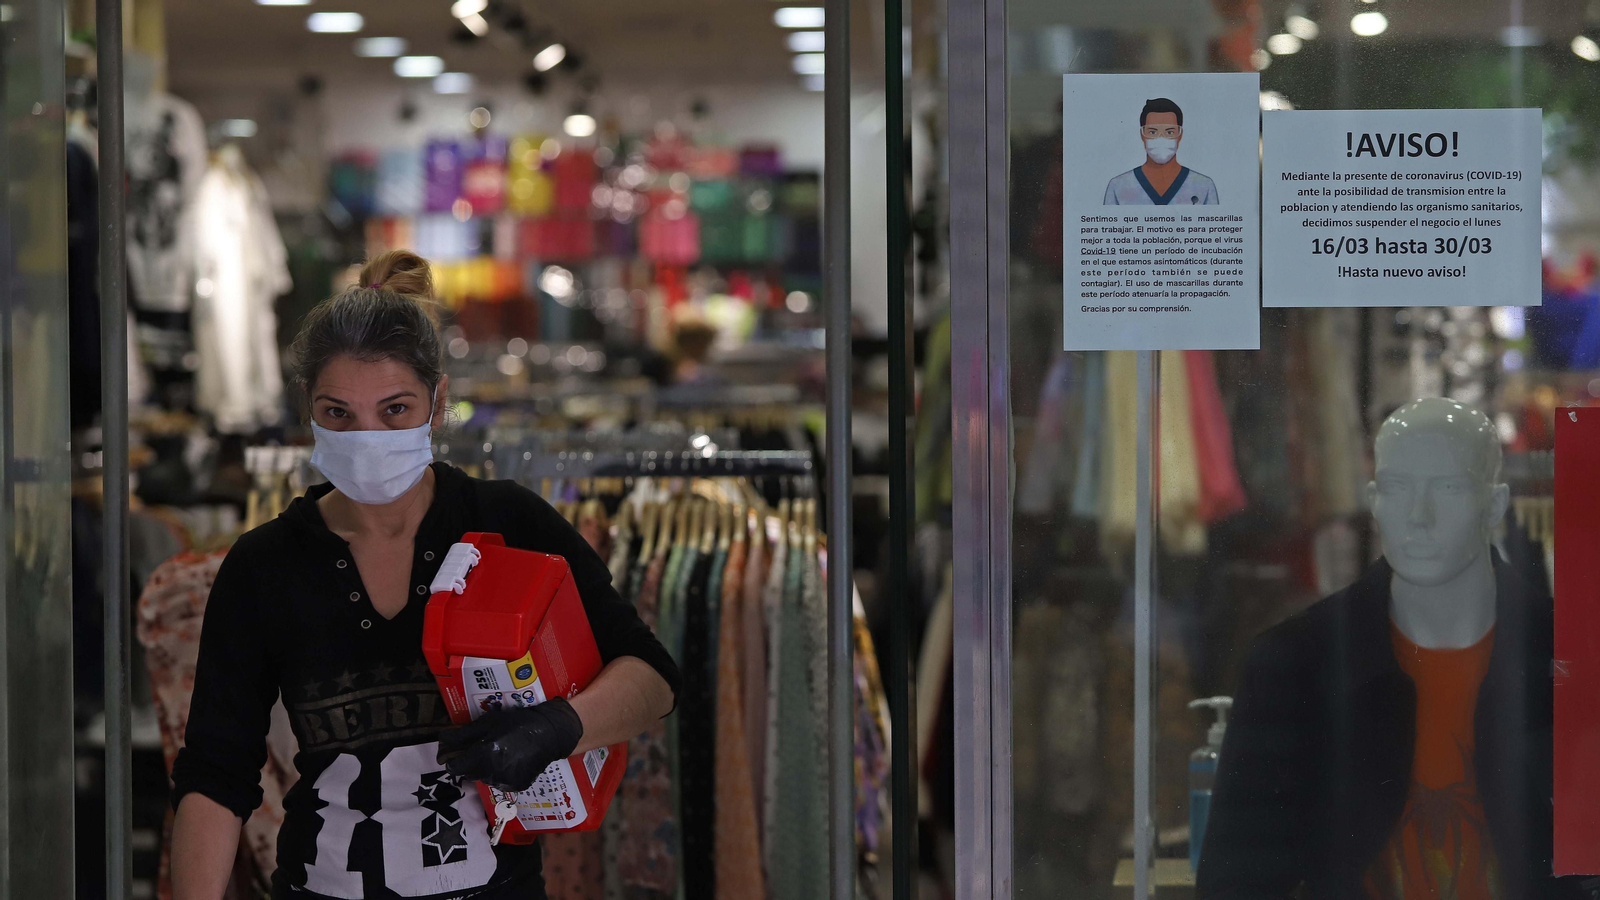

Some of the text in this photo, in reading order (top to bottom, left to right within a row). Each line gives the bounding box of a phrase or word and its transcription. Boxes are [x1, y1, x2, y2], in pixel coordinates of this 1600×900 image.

[1347, 131, 1458, 157] !AVISO!
[1281, 170, 1522, 183] Mediante la presente de coronavirus (COVID-19)
[1297, 185, 1507, 199] ante la posibilidad de transmision entre la
[1280, 201, 1524, 215] poblacion y atendiendo las organismo sanitarios,
[1080, 215, 1119, 223] Sentimos
[1122, 216, 1139, 224] que
[1180, 214, 1193, 223] las
[1197, 214, 1244, 223] mascarillas
[1301, 217, 1502, 229] decidimos suspender el negocio el lunes
[1080, 227, 1099, 235] para
[1100, 225, 1135, 235] trabajar.
[1136, 225, 1145, 233] El
[1146, 225, 1174, 234] motivo
[1187, 226, 1207, 235] para
[1208, 225, 1244, 235] proteger
[1080, 236, 1104, 246] mejor
[1112, 236, 1131, 244] toda
[1132, 236, 1141, 244] la
[1141, 235, 1183, 246] población,
[1183, 237, 1213, 245] porque
[1214, 236, 1222, 244] el
[1223, 235, 1244, 244] virus
[1080, 247, 1117, 256] Covid-19
[1118, 246, 1139, 255] tiene
[1154, 246, 1186, 256] período
[1187, 246, 1199, 255] de
[1201, 246, 1244, 255] incubación
[1312, 236, 1492, 257] 16/03 hasta 30/03
[1092, 257, 1100, 266] el
[1101, 259, 1117, 267] que
[1118, 258, 1152, 266] estamos
[1153, 257, 1208, 266] asintomáticos
[1209, 257, 1244, 266] (durante
[1080, 269, 1102, 277] este
[1107, 268, 1147, 278] período
[1151, 267, 1192, 276] también
[1213, 268, 1244, 277] puede
[1337, 265, 1466, 278] !Hasta nuevo aviso!
[1080, 279, 1123, 289] contagiar).
[1125, 279, 1134, 287] El
[1152, 279, 1164, 287] de
[1165, 278, 1210, 287] mascarillas
[1212, 278, 1244, 287] durante
[1099, 290, 1131, 300] período
[1131, 289, 1170, 298] atenuaría
[1170, 289, 1179, 298] la
[1179, 289, 1231, 299] propagación.
[1080, 304, 1111, 313] Gracias
[1111, 306, 1127, 314] por
[1138, 304, 1192, 314] comprensión.
[474, 669, 489, 690] 250
[298, 694, 451, 744] BERL
